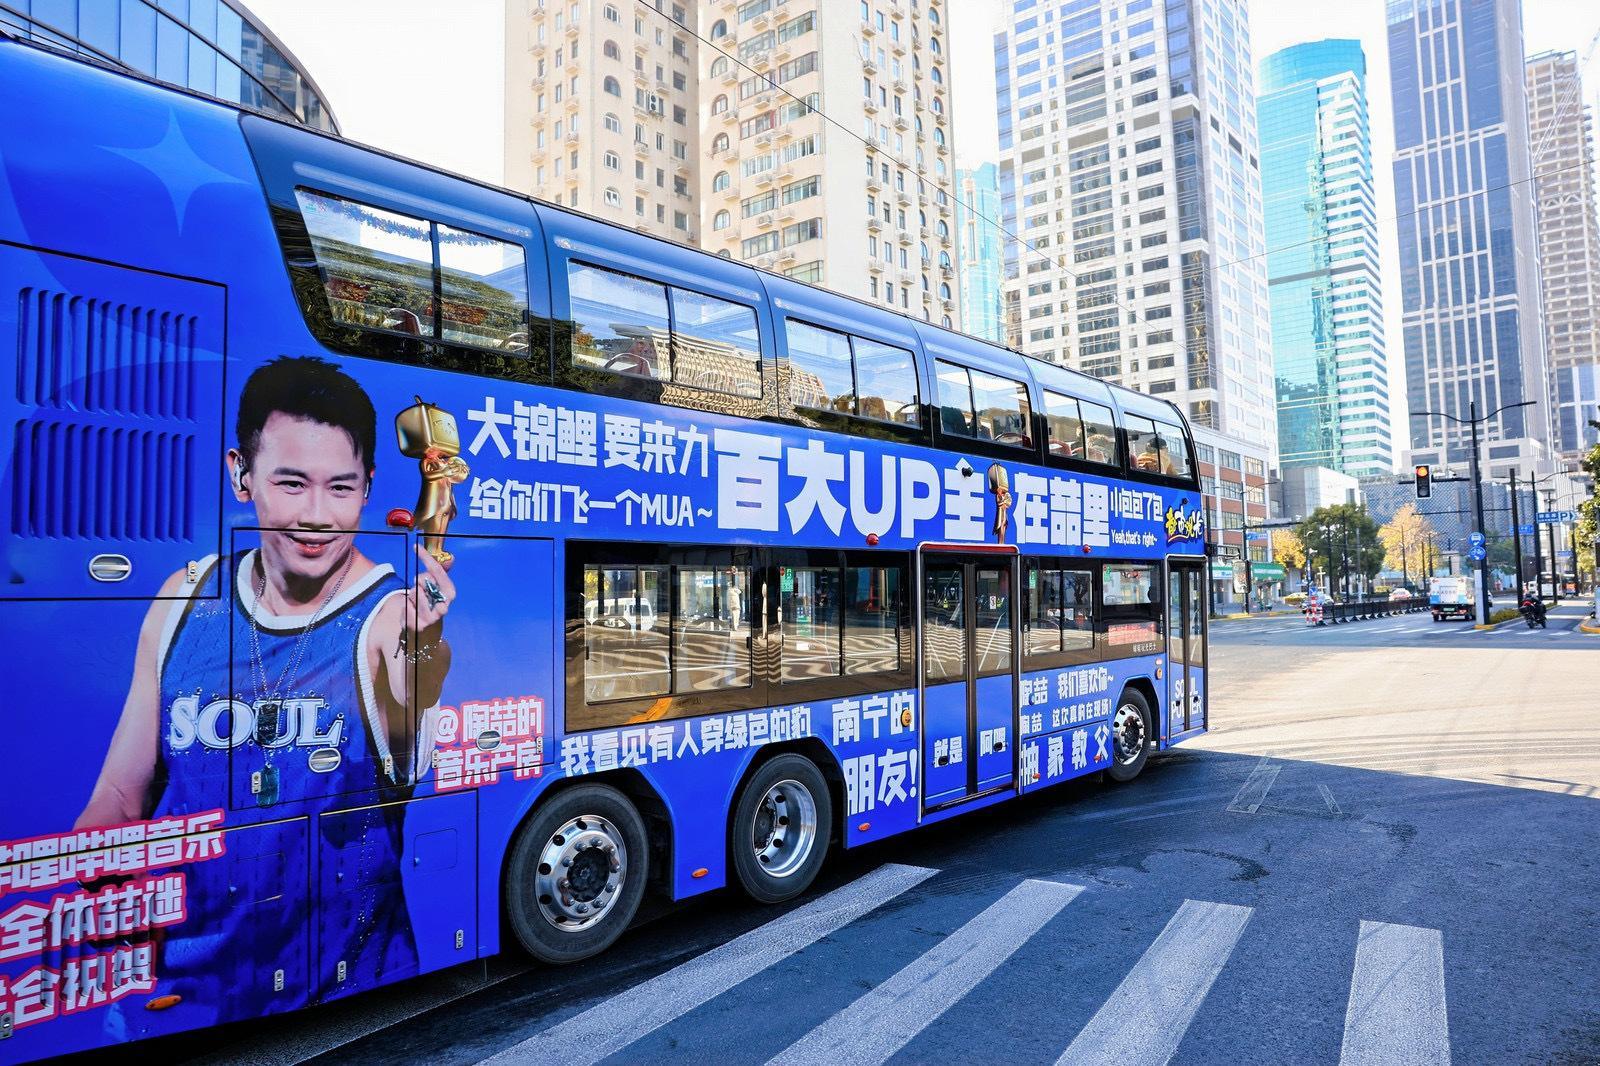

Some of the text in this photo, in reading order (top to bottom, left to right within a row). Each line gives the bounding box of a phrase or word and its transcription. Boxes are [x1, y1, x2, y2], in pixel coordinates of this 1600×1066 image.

[714, 428, 1110, 547] 百大UP主 在喆里
[168, 694, 343, 750] SOUL
[831, 691, 915, 746] 南宁的
[844, 747, 918, 817] 朋友!
[0, 876, 183, 958] 全体喆迷
